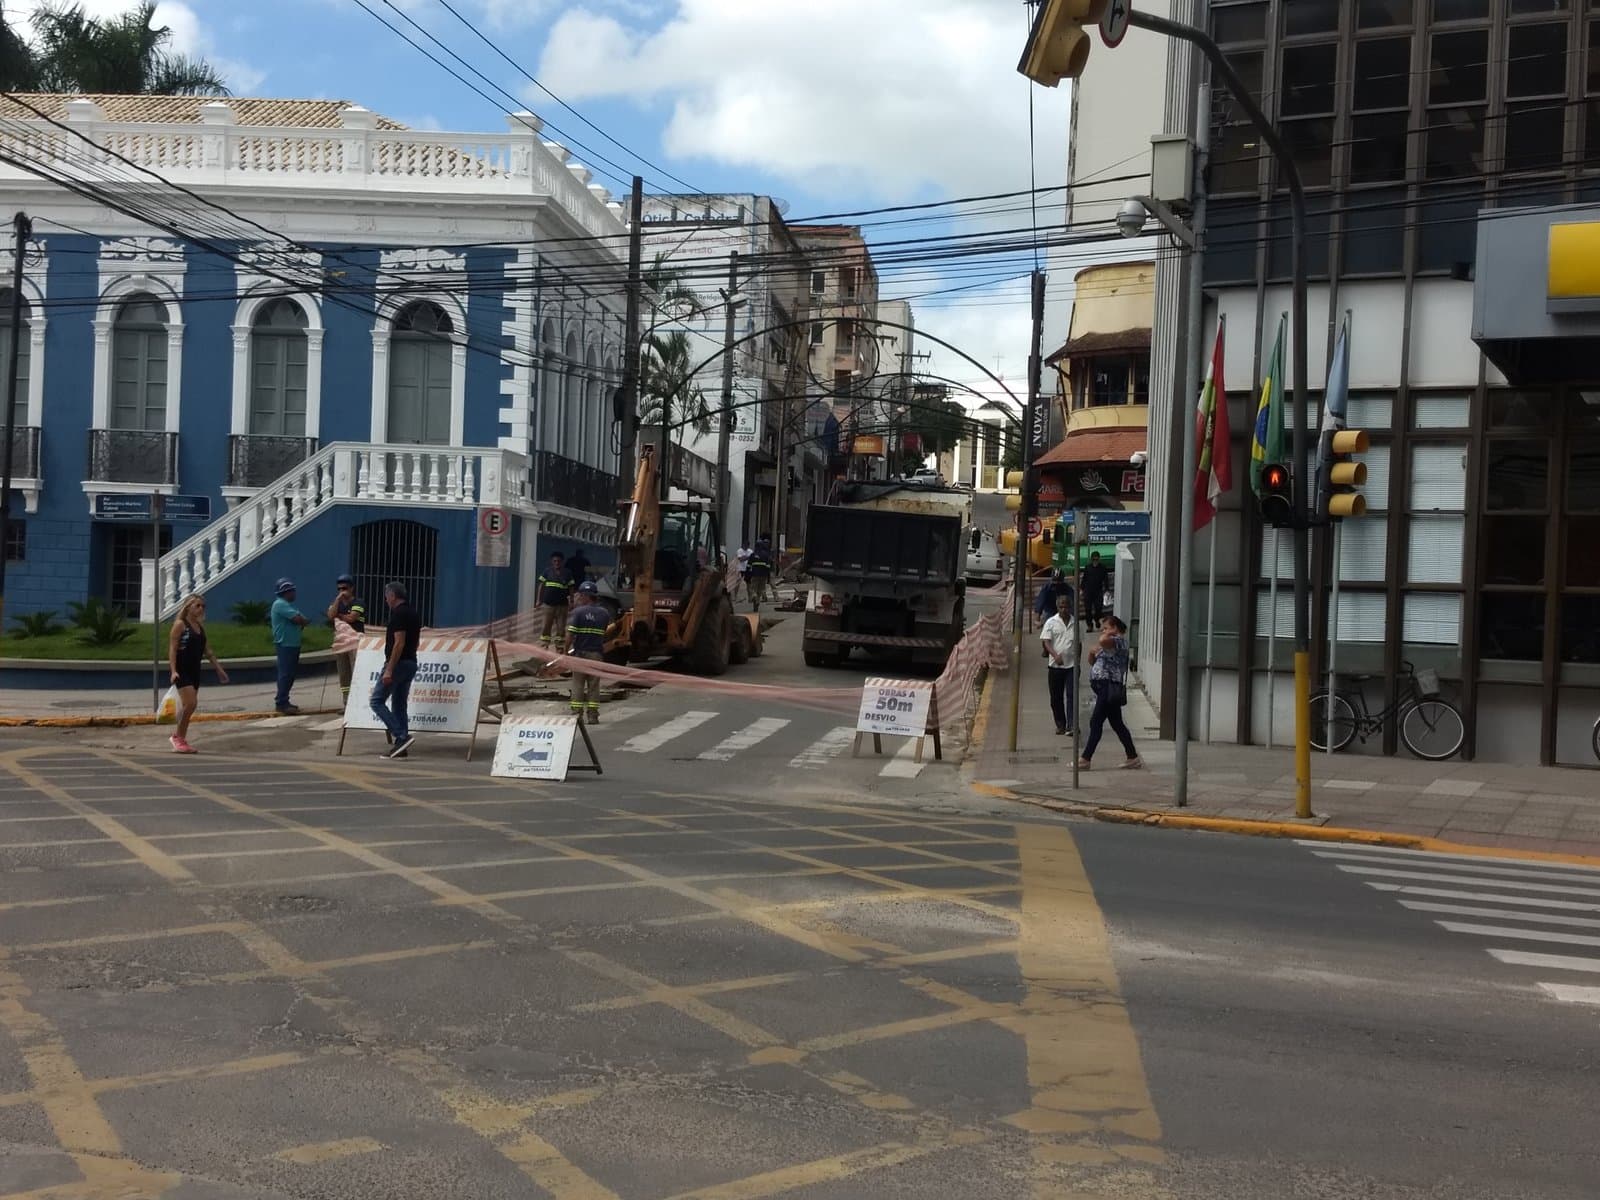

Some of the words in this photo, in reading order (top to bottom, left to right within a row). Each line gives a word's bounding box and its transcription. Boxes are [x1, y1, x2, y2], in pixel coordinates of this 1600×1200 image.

[1033, 404, 1043, 447] NOVA
[1120, 470, 1145, 492] Fa
[490, 514, 499, 530] E
[879, 688, 907, 698] OBRAS
[876, 697, 913, 713] 50m
[865, 712, 897, 722] DESVIO
[518, 730, 554, 739] DESVIO
